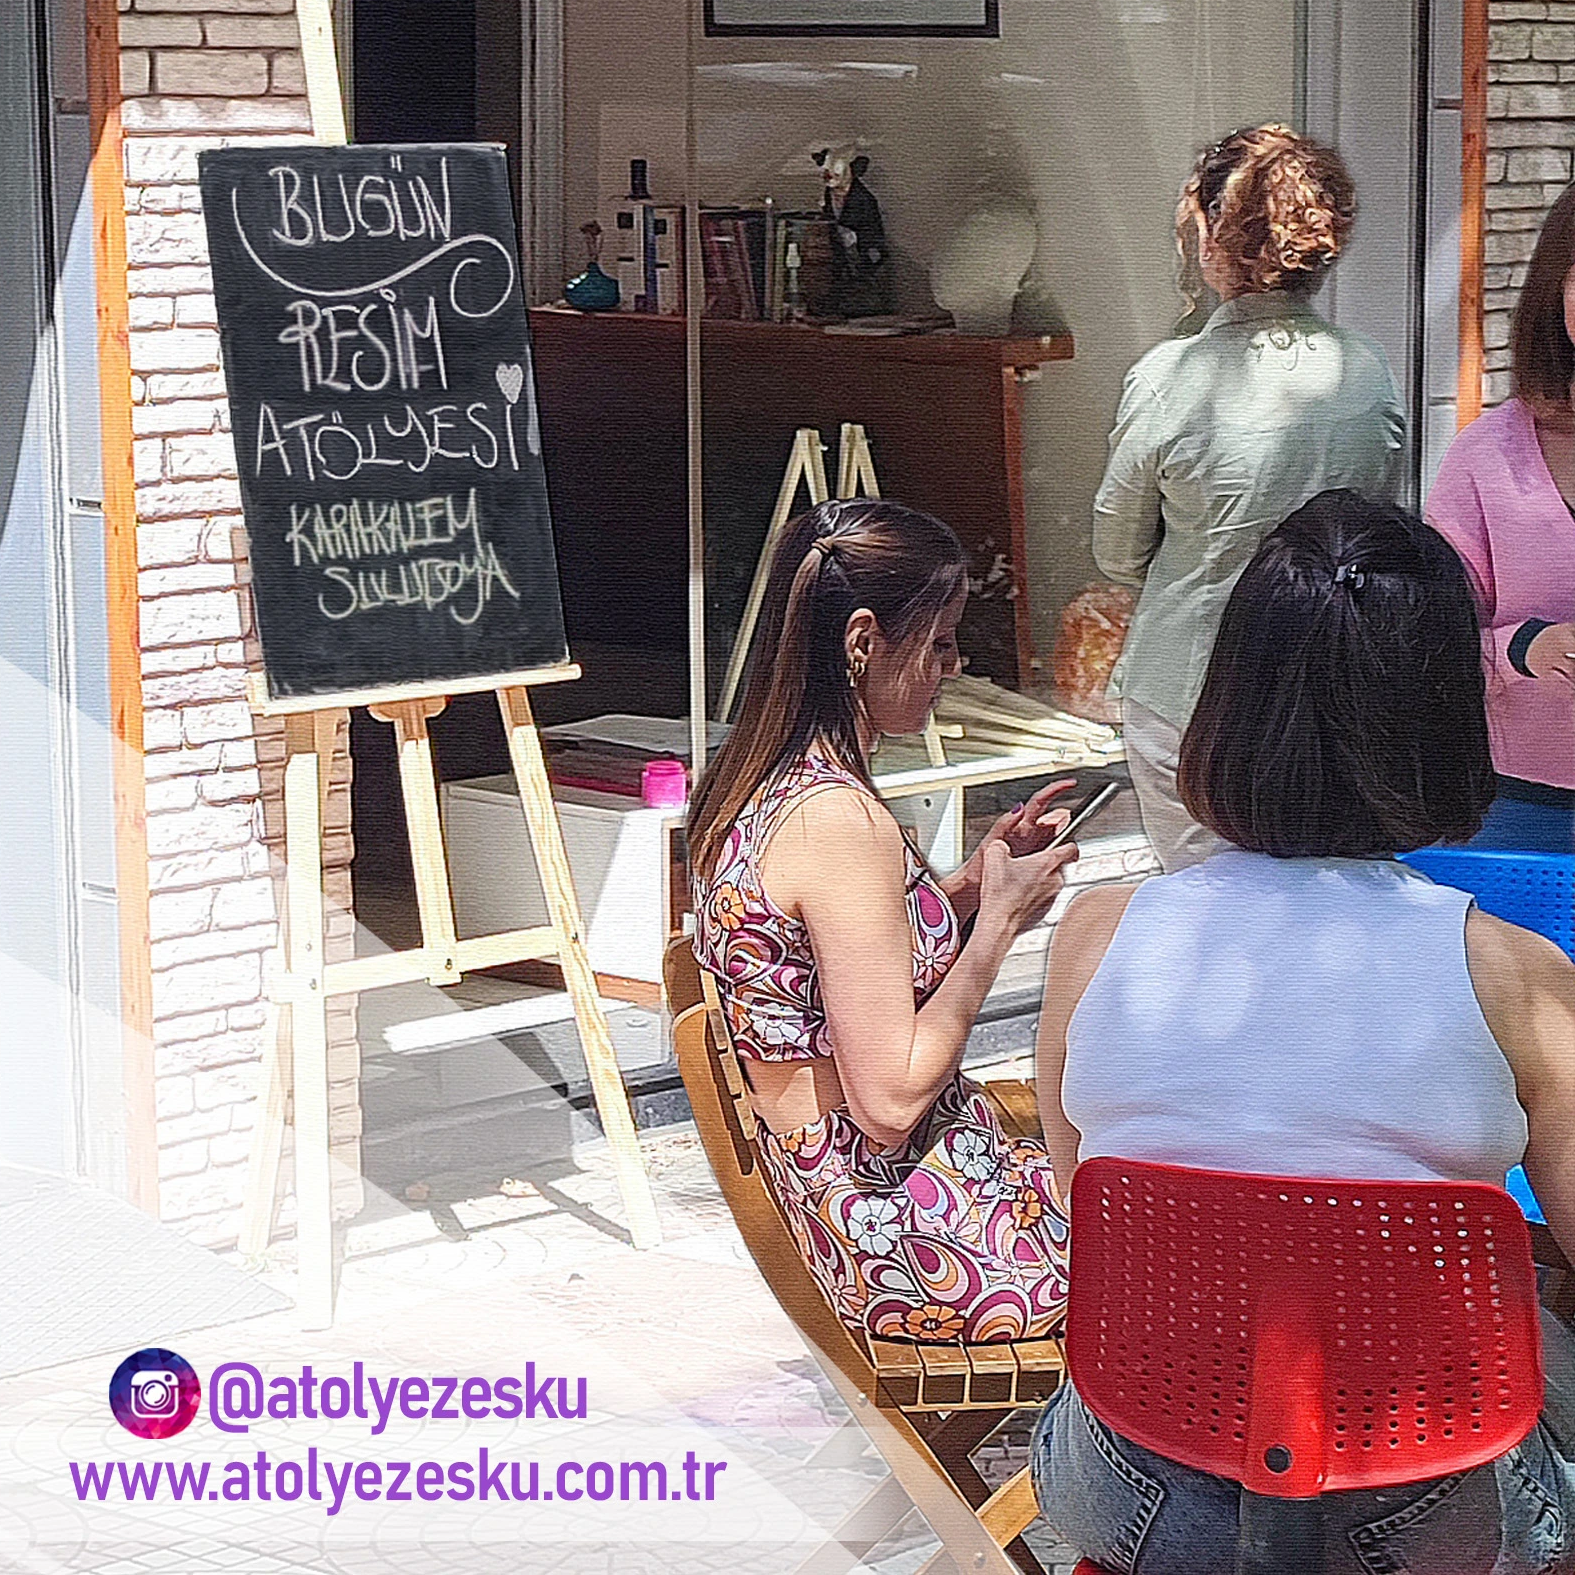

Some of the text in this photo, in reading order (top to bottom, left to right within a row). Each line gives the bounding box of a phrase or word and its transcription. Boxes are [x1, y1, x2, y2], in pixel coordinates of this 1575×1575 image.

[269, 156, 452, 246] BUGÜN
[279, 288, 449, 391] RESİM
[286, 488, 484, 566] KARAKALEM
